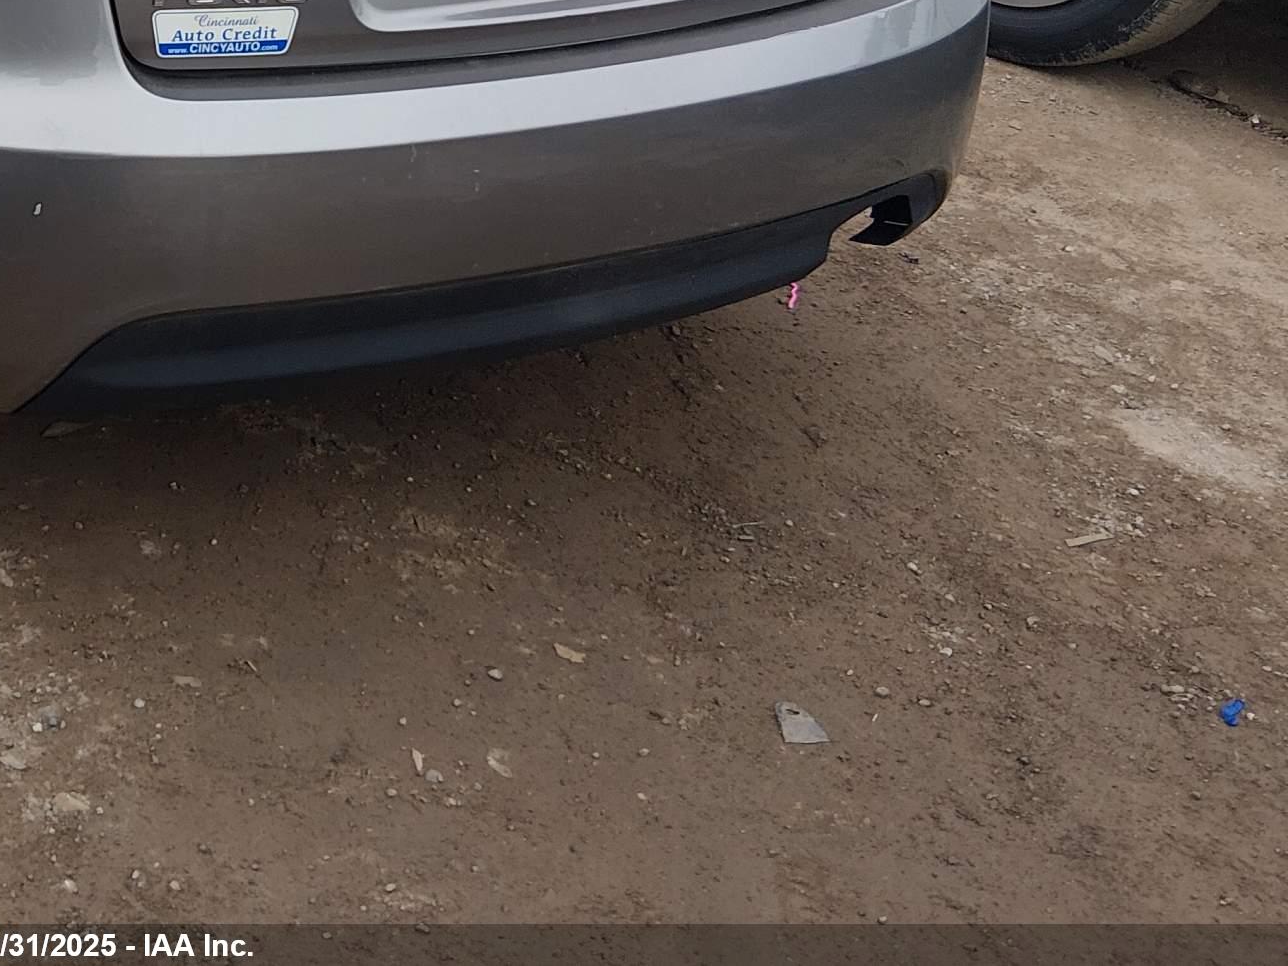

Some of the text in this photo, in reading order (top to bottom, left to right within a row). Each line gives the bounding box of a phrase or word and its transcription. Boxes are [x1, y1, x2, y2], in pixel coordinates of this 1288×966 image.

[195, 15, 258, 28] Cincinnati
[172, 26, 277, 42] Auto Credit
